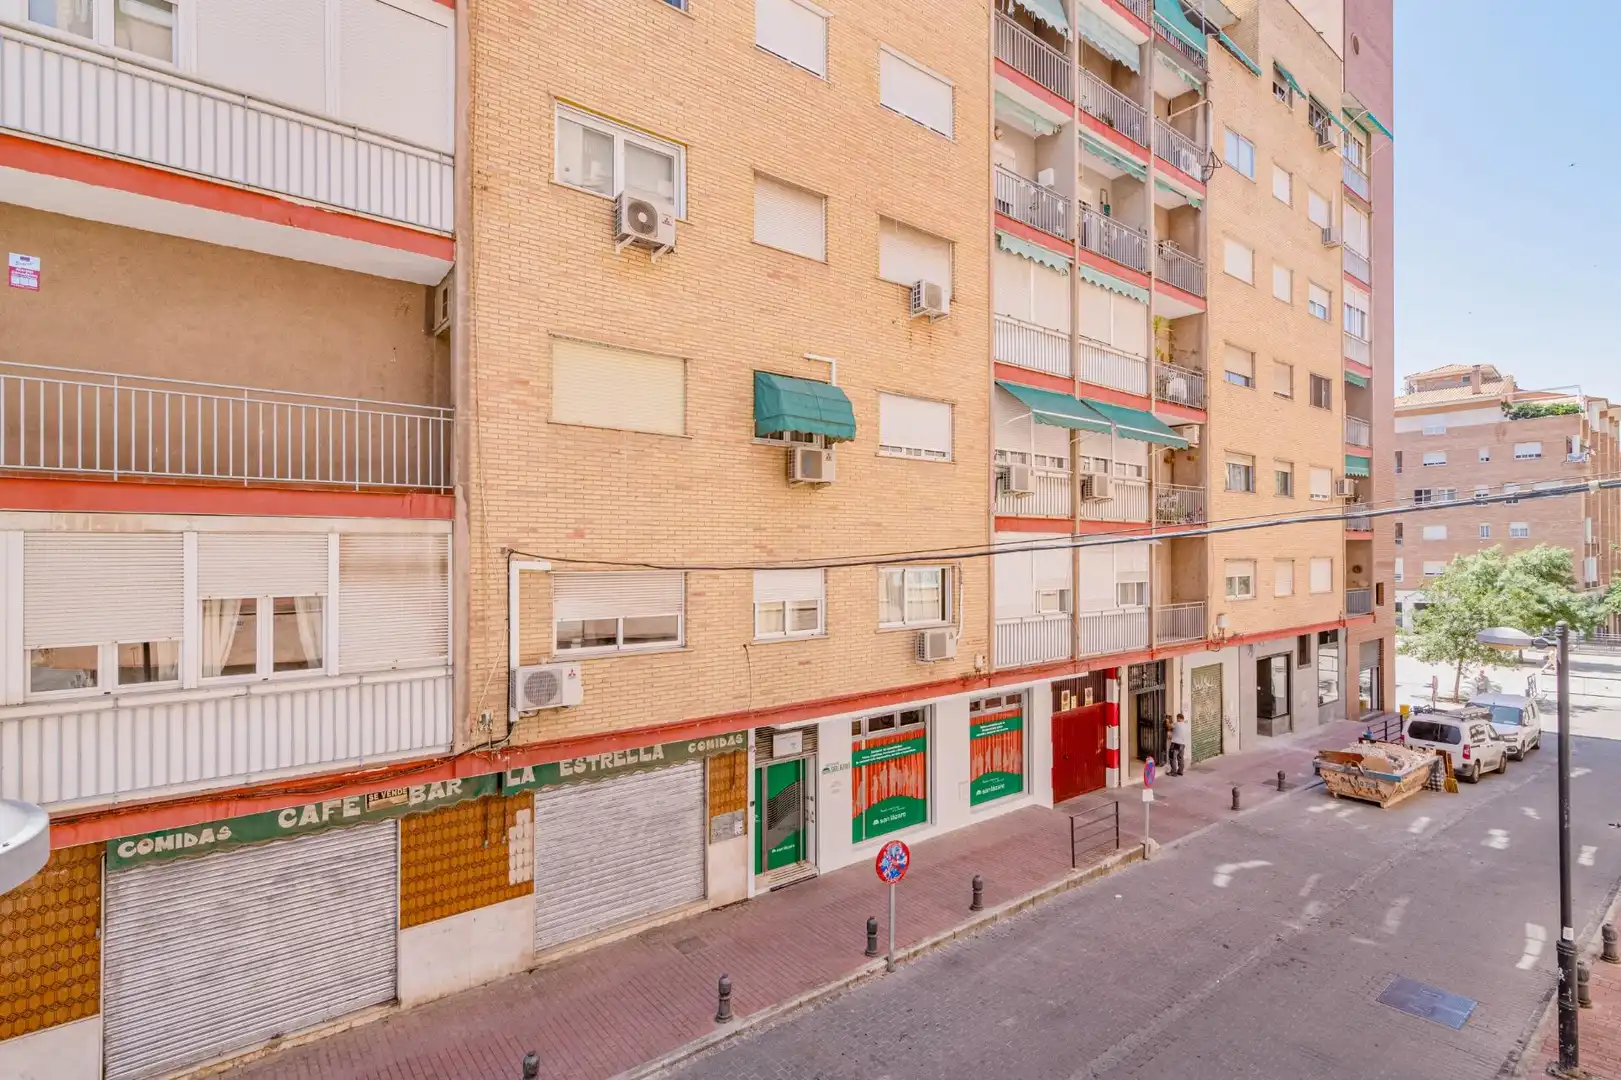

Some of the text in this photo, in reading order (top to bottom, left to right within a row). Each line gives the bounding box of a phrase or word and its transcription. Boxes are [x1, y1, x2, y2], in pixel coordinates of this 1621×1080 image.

[687, 733, 744, 753] COMIDAS
[506, 744, 664, 787] LA ESTRELLA
[278, 778, 463, 829] CAFE BAR
[368, 787, 408, 802] SE VENDE
[117, 825, 232, 858] COMIDAS
